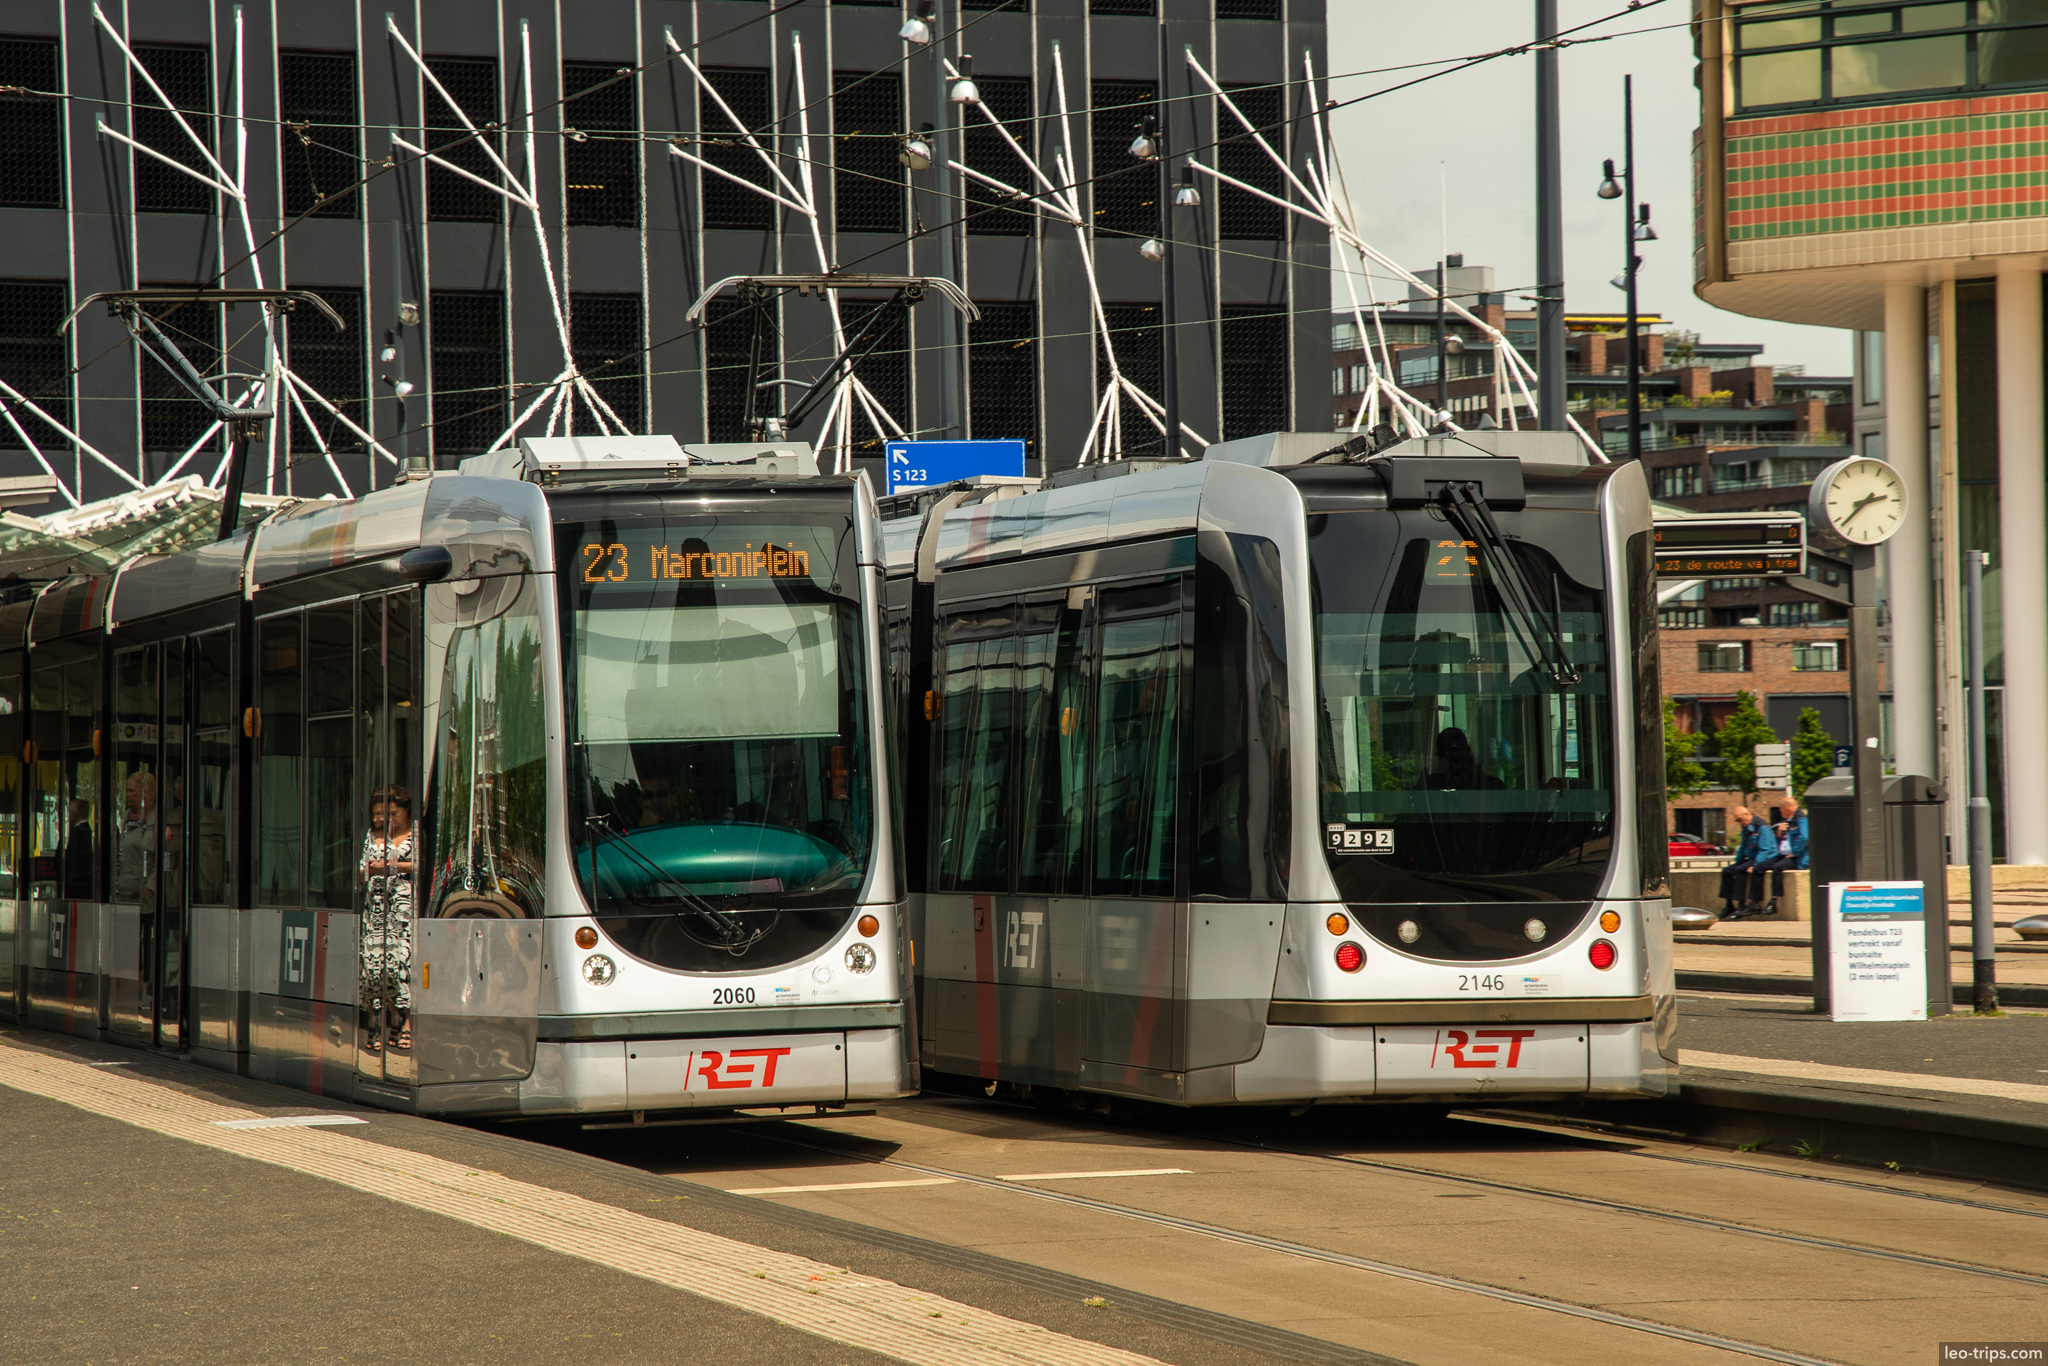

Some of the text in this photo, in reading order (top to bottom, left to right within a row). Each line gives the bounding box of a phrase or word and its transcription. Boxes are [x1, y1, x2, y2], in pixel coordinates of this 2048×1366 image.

[893, 469, 927, 481] S 123
[583, 542, 809, 582] 23 Marconiplein
[1665, 560, 1680, 570] 23
[1686, 560, 1702, 570] de
[1707, 558, 1743, 569] route
[1332, 833, 1388, 845] 9292
[1848, 928, 1887, 936] Pendelbus
[1008, 911, 1044, 968] RET
[1882, 939, 1902, 947] vanaf
[1848, 961, 1911, 970] Wilhelminaplein
[1458, 974, 1504, 991] 2146
[1849, 972, 1857, 982] (2
[1875, 972, 1900, 982] lopen)
[712, 987, 756, 1004] 2060
[1445, 1029, 1535, 1068] RET
[698, 1047, 792, 1089] RET
